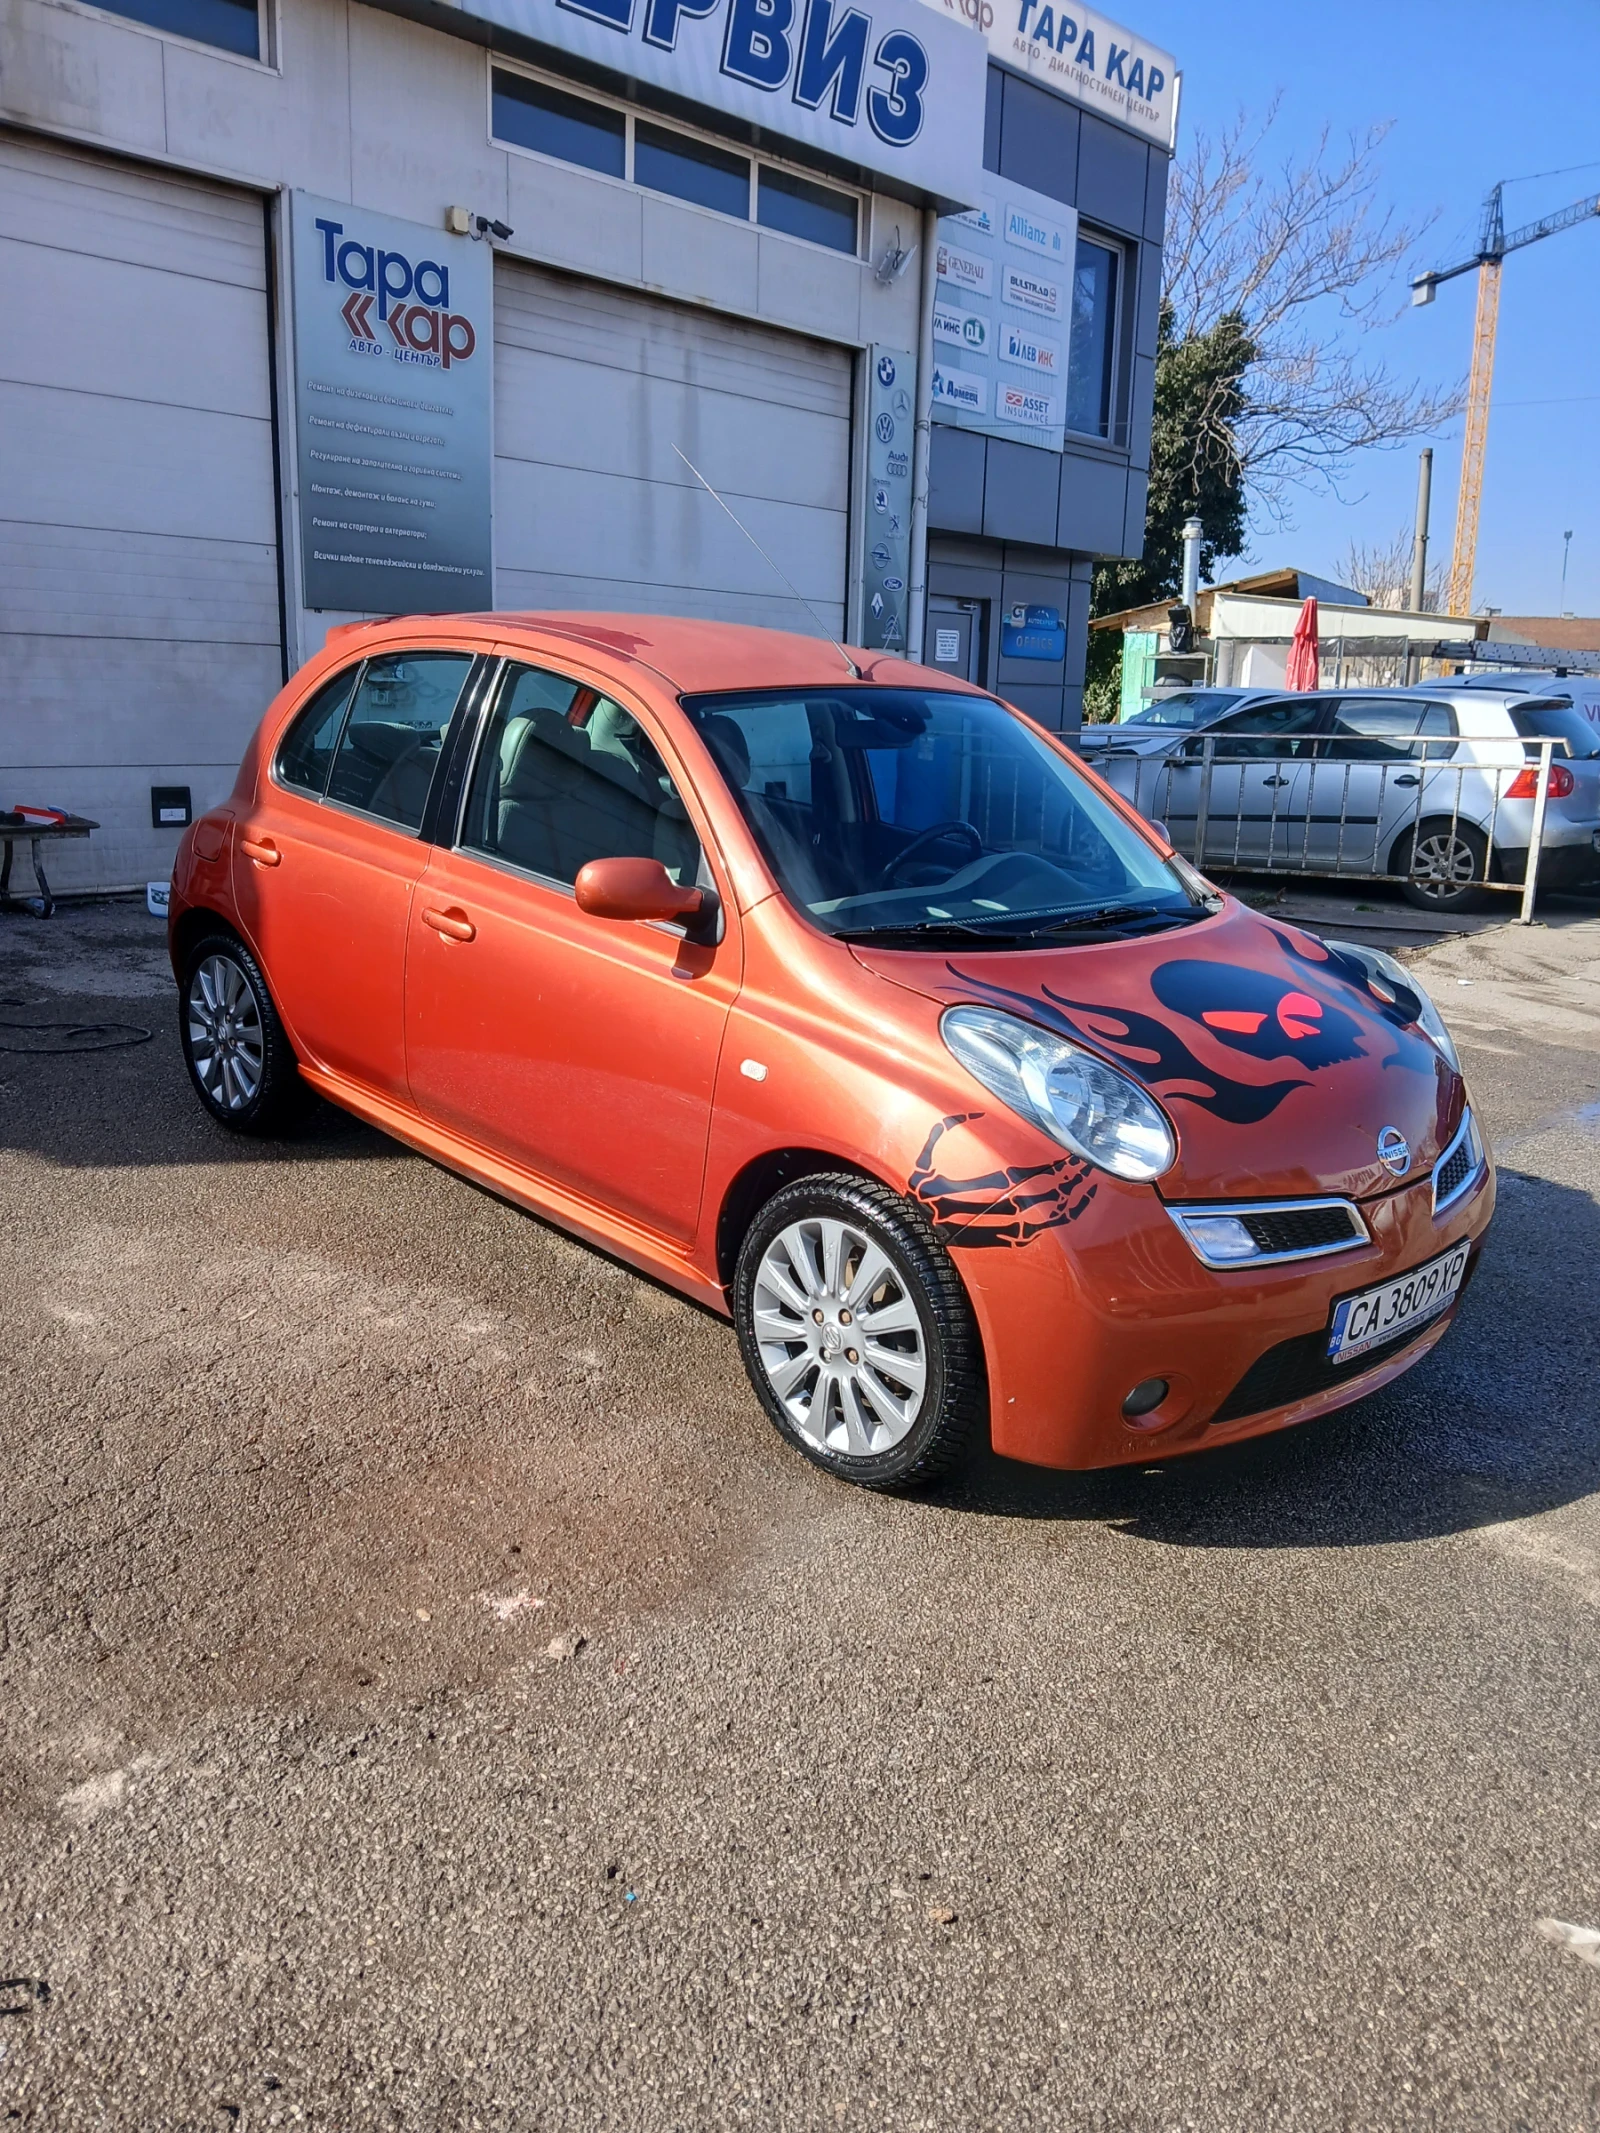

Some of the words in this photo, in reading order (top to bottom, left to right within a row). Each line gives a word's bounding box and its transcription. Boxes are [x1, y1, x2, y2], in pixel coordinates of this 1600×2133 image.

[1017, 0, 1096, 72] ТАРА
[1105, 42, 1165, 102] КАР
[1012, 37, 1041, 60] АВТО
[1048, 56, 1125, 105] ДИАГНОСТИЧЕН
[1126, 96, 1161, 123] ЦЕНТЪР
[1009, 214, 1047, 246] Allianz
[948, 255, 985, 280] GENERALI
[1010, 275, 1049, 297] BULSTRAD
[943, 320, 961, 335] ИНС
[349, 339, 383, 356] АВТО
[394, 348, 441, 367] ЦЕНТЪР
[1021, 344, 1037, 362] ЛЕВ
[1037, 348, 1054, 368] ИНС
[308, 381, 334, 393] Ремонт
[946, 379, 978, 406] Армеец
[1004, 404, 1050, 426] INSURANCE
[1023, 396, 1050, 414] ASSET
[309, 415, 335, 427] Ремонт
[310, 449, 351, 464] Регулиране
[888, 450, 908, 462] Audi
[311, 483, 343, 496] Монтаж,
[344, 487, 380, 501] демонтаж
[312, 517, 338, 528] Ремонт
[349, 523, 379, 534] стартери
[314, 550, 339, 561] Всички
[340, 553, 364, 564] видове
[365, 557, 416, 569] тенекеджийски
[1016, 635, 1053, 650] OFFICE
[1347, 1295, 1382, 1341] CA
[1383, 1268, 1440, 1326] 3809
[1436, 1251, 1465, 1298] XP
[1330, 1334, 1342, 1348] BG
[1336, 1340, 1372, 1362] NISSAN
